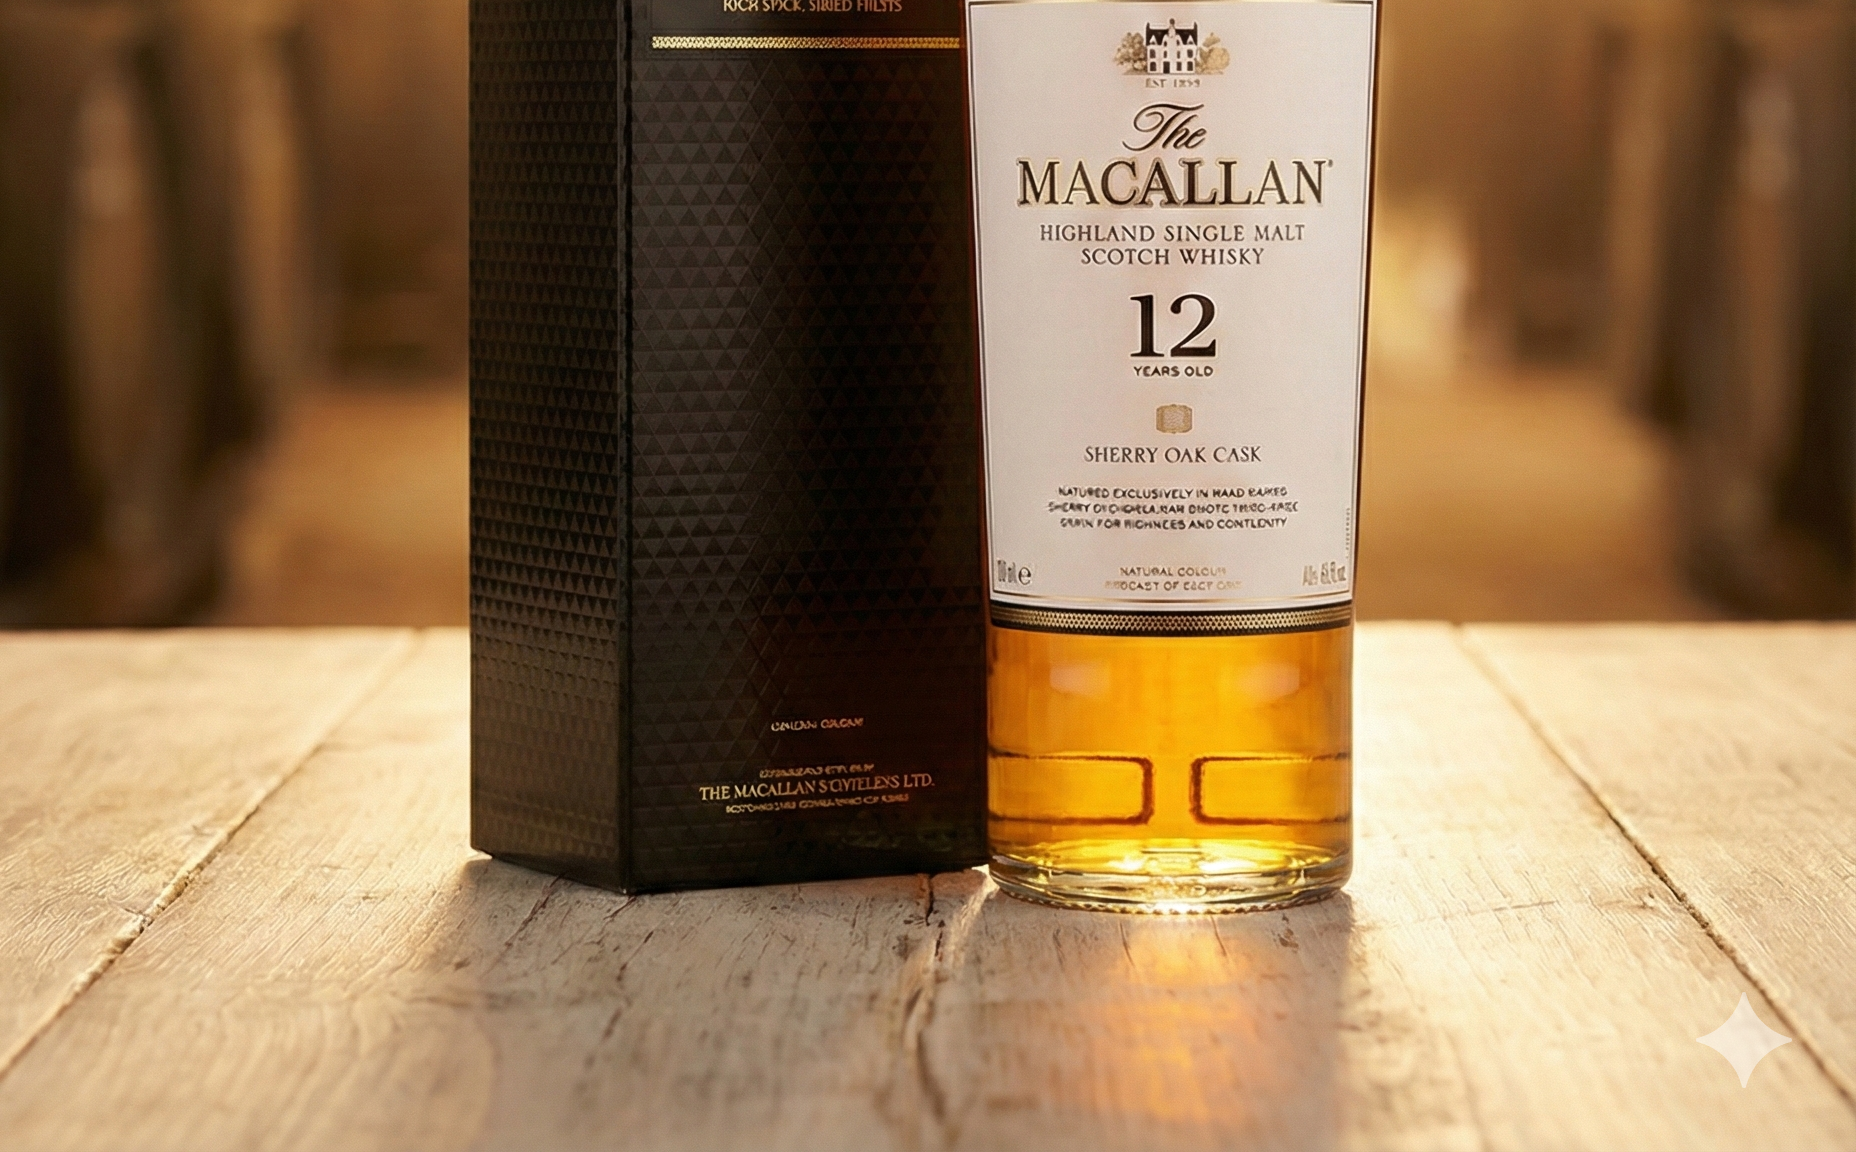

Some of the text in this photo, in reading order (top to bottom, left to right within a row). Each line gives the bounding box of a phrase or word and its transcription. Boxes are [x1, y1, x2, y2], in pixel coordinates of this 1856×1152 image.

[1121, 103, 1207, 152] The
[1017, 158, 1333, 207] MACALLAN
[1040, 224, 1305, 242] HIGHLAND SINGLE MALT
[1081, 248, 1265, 266] SCOTCH WHISKY
[1130, 293, 1216, 358] 12
[1133, 365, 1214, 378] YEARS OLD
[1084, 445, 1262, 464] SHERRY OAK CASK
[1188, 519, 1215, 530] AND
[699, 785, 732, 801] THE
[733, 779, 817, 799] MACALLAN
